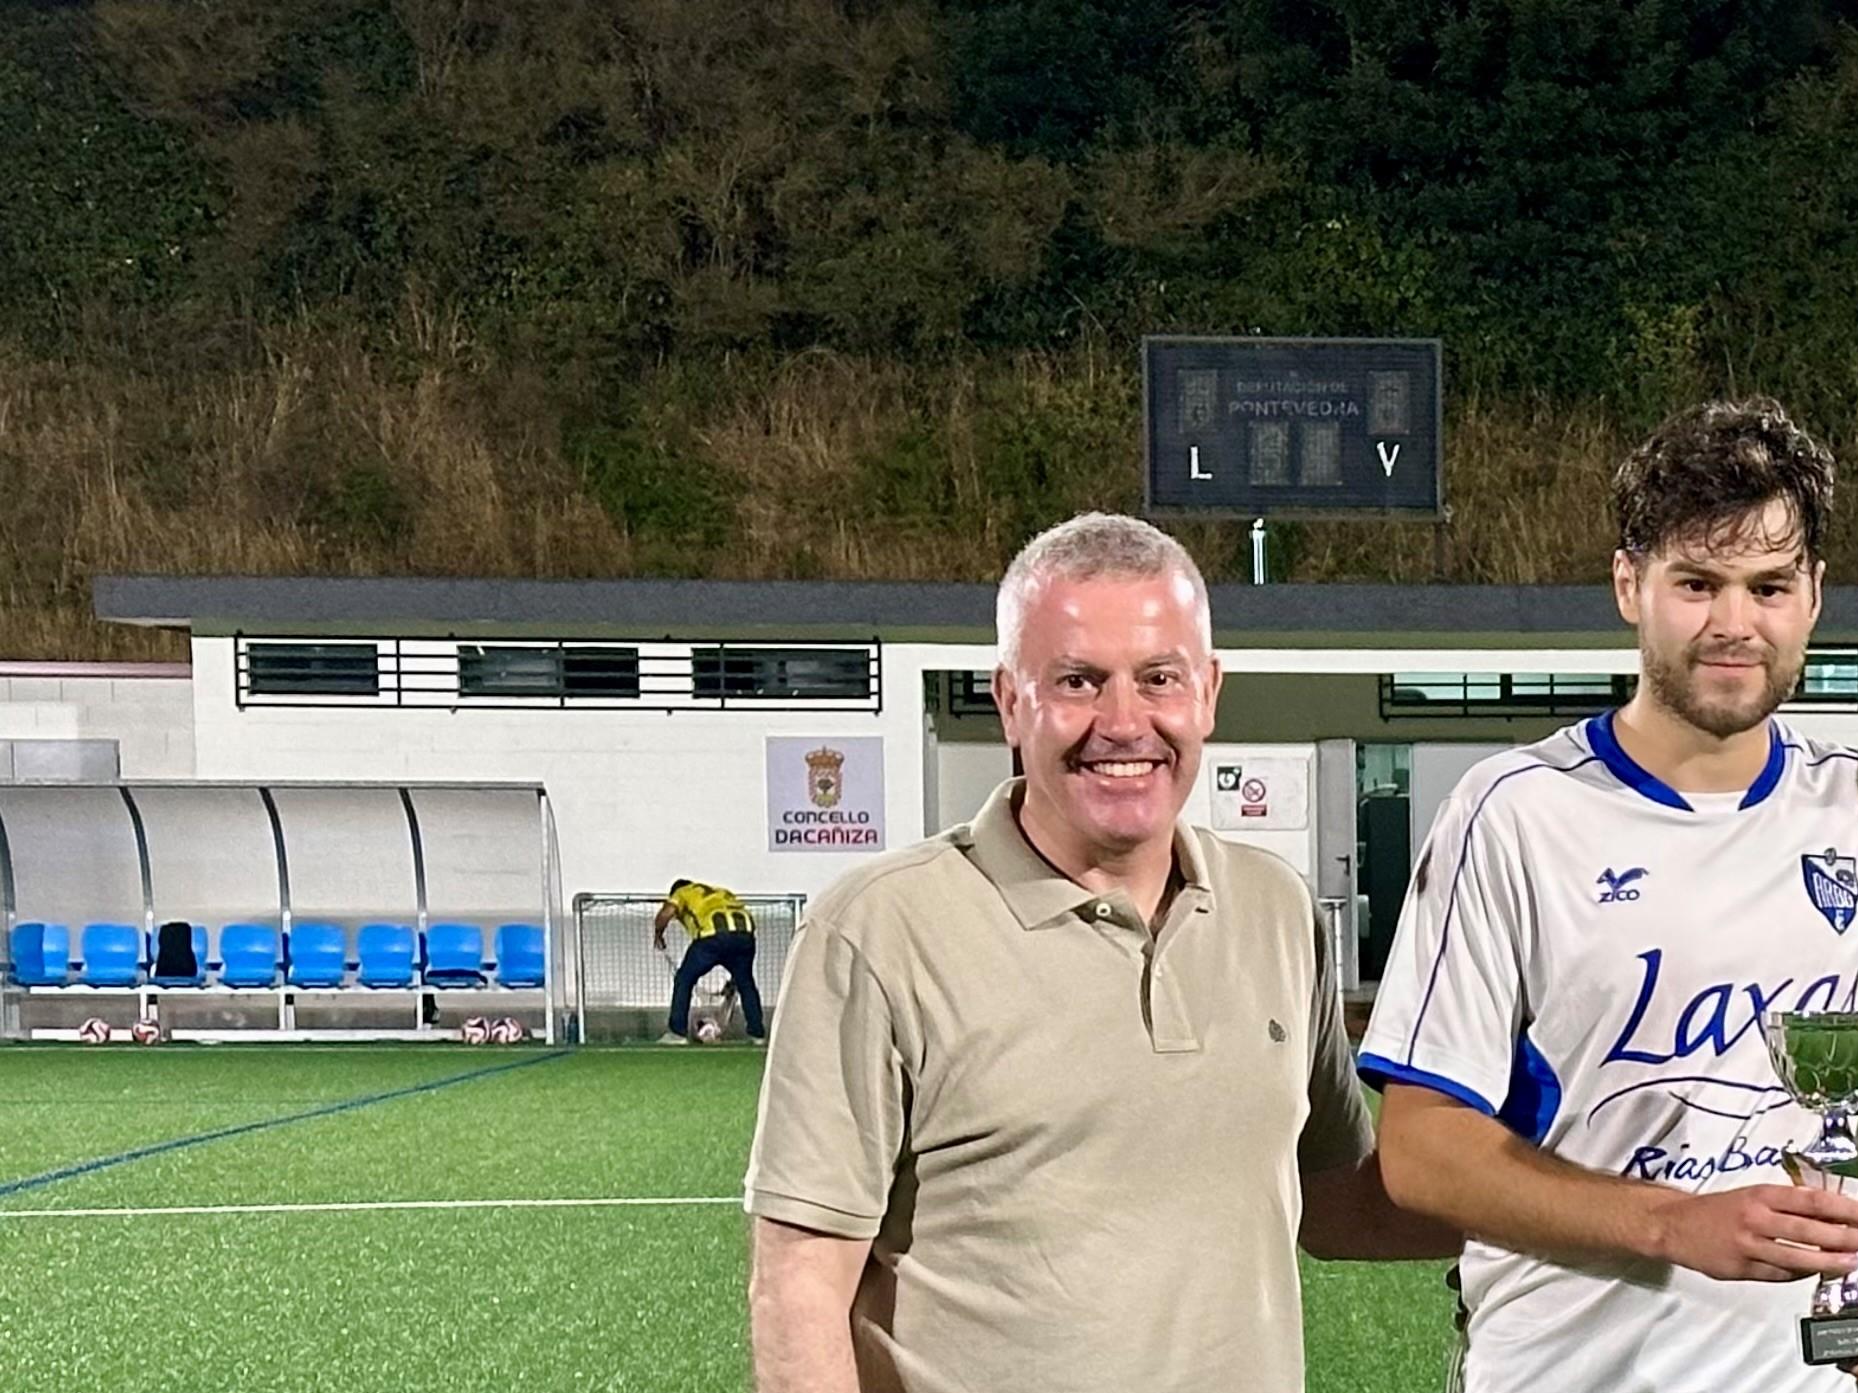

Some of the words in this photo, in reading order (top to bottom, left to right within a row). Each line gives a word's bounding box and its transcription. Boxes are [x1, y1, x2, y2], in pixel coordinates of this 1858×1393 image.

[1229, 400, 1359, 416] PONTEVEDRA
[1190, 446, 1213, 480] L
[1376, 441, 1400, 477] V
[783, 811, 869, 824] CONCELLO
[775, 826, 878, 844] DACAÑIZA
